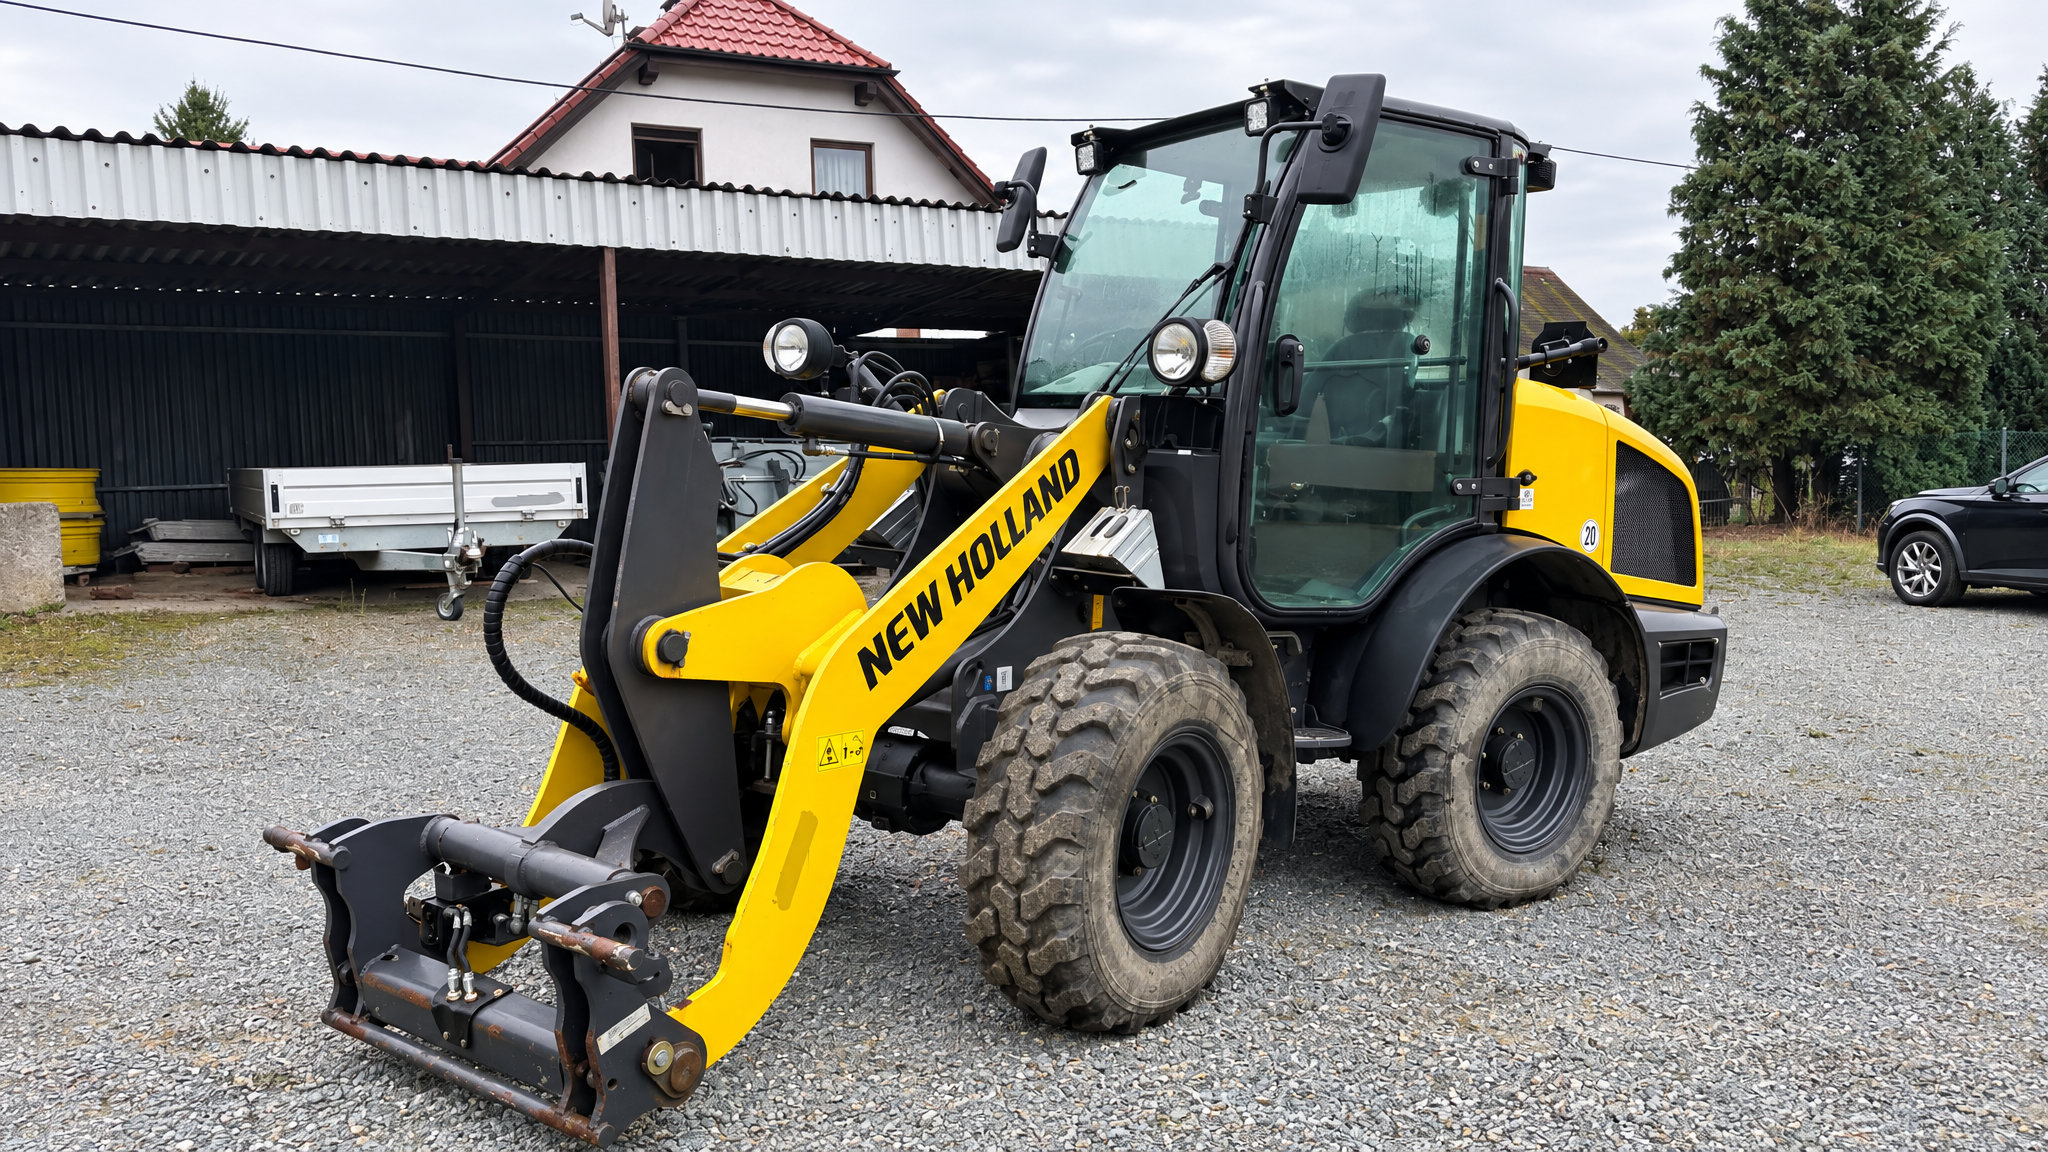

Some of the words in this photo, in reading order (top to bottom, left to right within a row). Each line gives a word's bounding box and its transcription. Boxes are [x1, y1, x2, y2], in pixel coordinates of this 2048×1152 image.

[857, 579, 943, 692] NEW
[945, 449, 1080, 607] HOLLAND
[1584, 526, 1596, 546] 20
